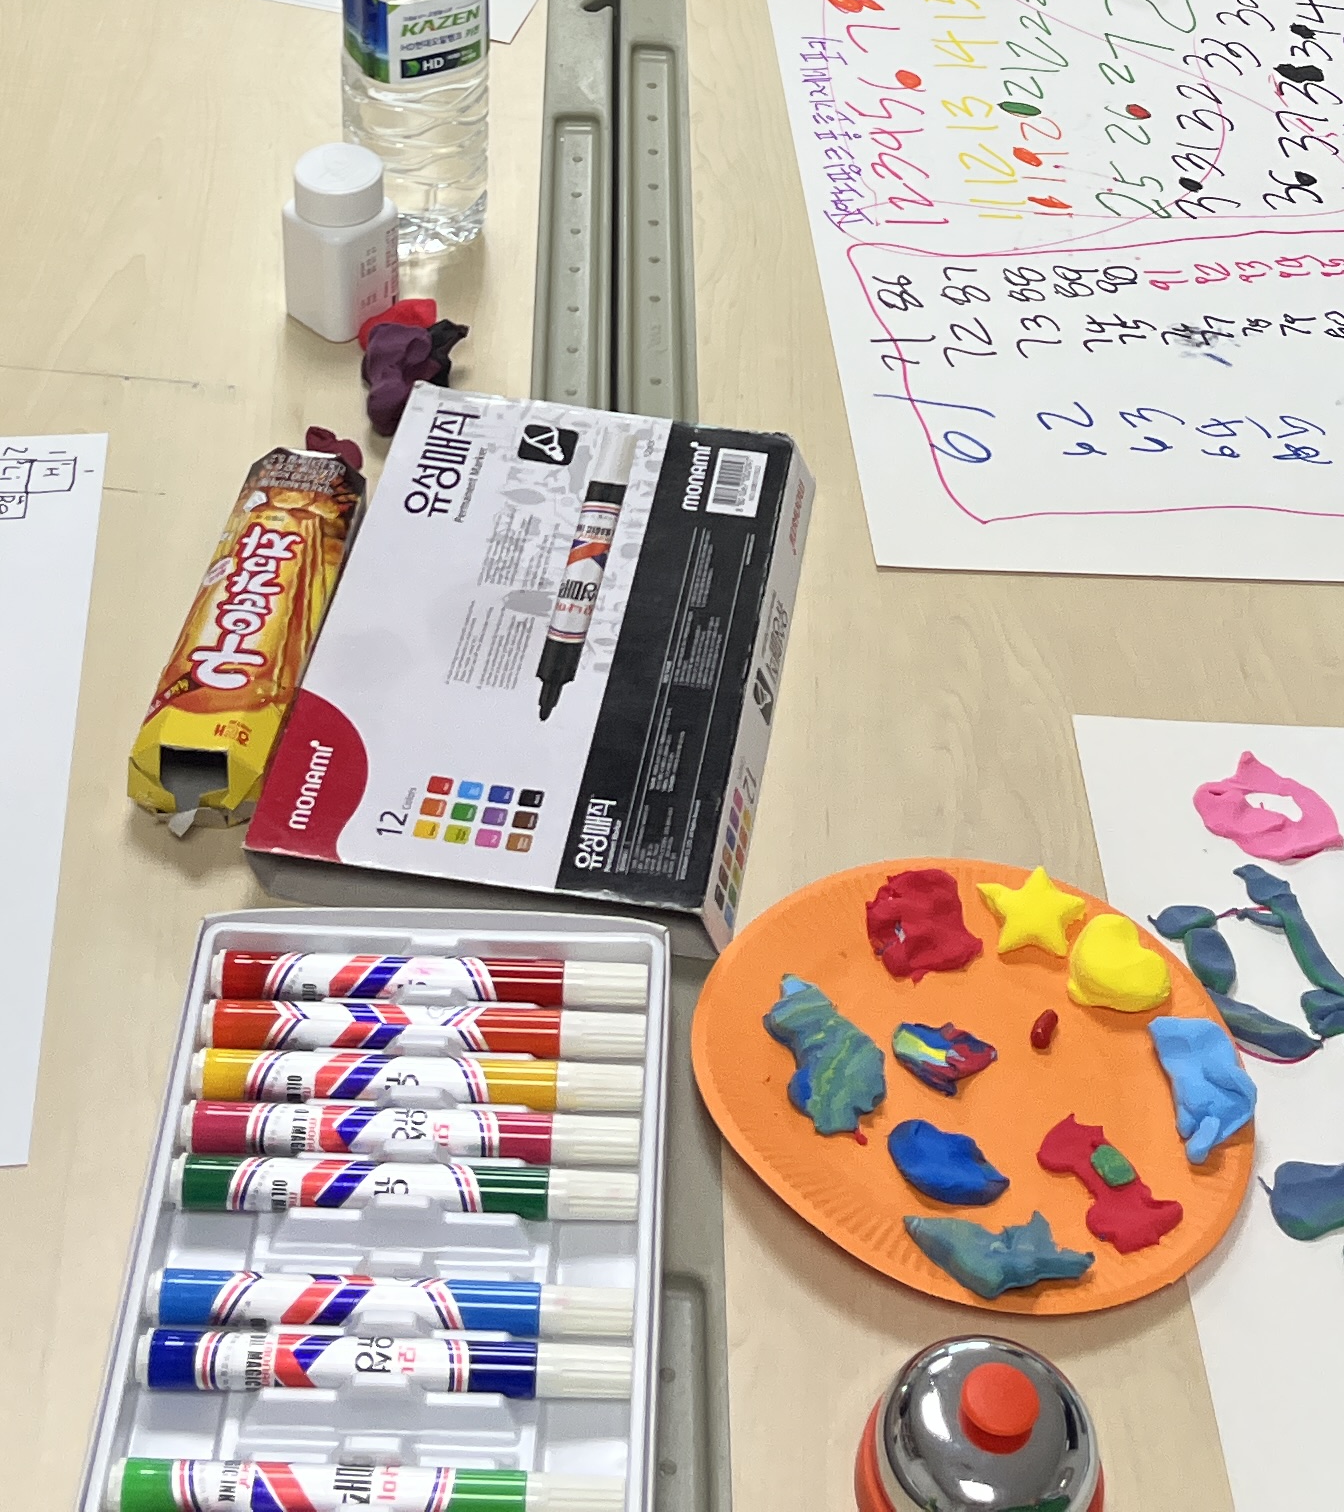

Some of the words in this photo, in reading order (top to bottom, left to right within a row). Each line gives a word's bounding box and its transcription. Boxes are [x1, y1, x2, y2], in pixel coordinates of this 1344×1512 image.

[401, 4, 481, 37] KAZEN
[846, 24, 901, 54] 7
[422, 57, 445, 71] HD
[930, 30, 1000, 69] 14
[1098, 33, 1175, 85] 27
[844, 98, 926, 119] 5
[940, 95, 999, 130] 13
[1175, 82, 1234, 132] 32
[1275, 111, 1339, 158] 37
[871, 152, 930, 180] 3
[957, 143, 1018, 184] 12
[1171, 142, 1225, 177] 31
[887, 182, 935, 211] 2
[1095, 161, 1172, 219] 25
[1262, 169, 1323, 210] 36
[940, 266, 991, 306] 87
[1002, 266, 1047, 303] 88
[1051, 264, 1099, 298] 89
[1095, 265, 1139, 294] 90
[1142, 269, 1189, 292] 91
[1234, 259, 1270, 283] 93
[871, 273, 924, 312] 86
[942, 316, 998, 368] 72
[1015, 313, 1062, 360] 73
[1279, 312, 1317, 337] 79
[0, 466, 20, 481] Li
[43, 467, 59, 478] H
[404, 407, 481, 518] 유성매직
[681, 441, 714, 512] monami
[454, 477, 479, 524] Permanent
[468, 445, 488, 479] Marker
[188, 524, 306, 690] 구운감자
[287, 738, 334, 831] monami
[375, 809, 409, 837] 12
[574, 794, 616, 870] 유성매직
